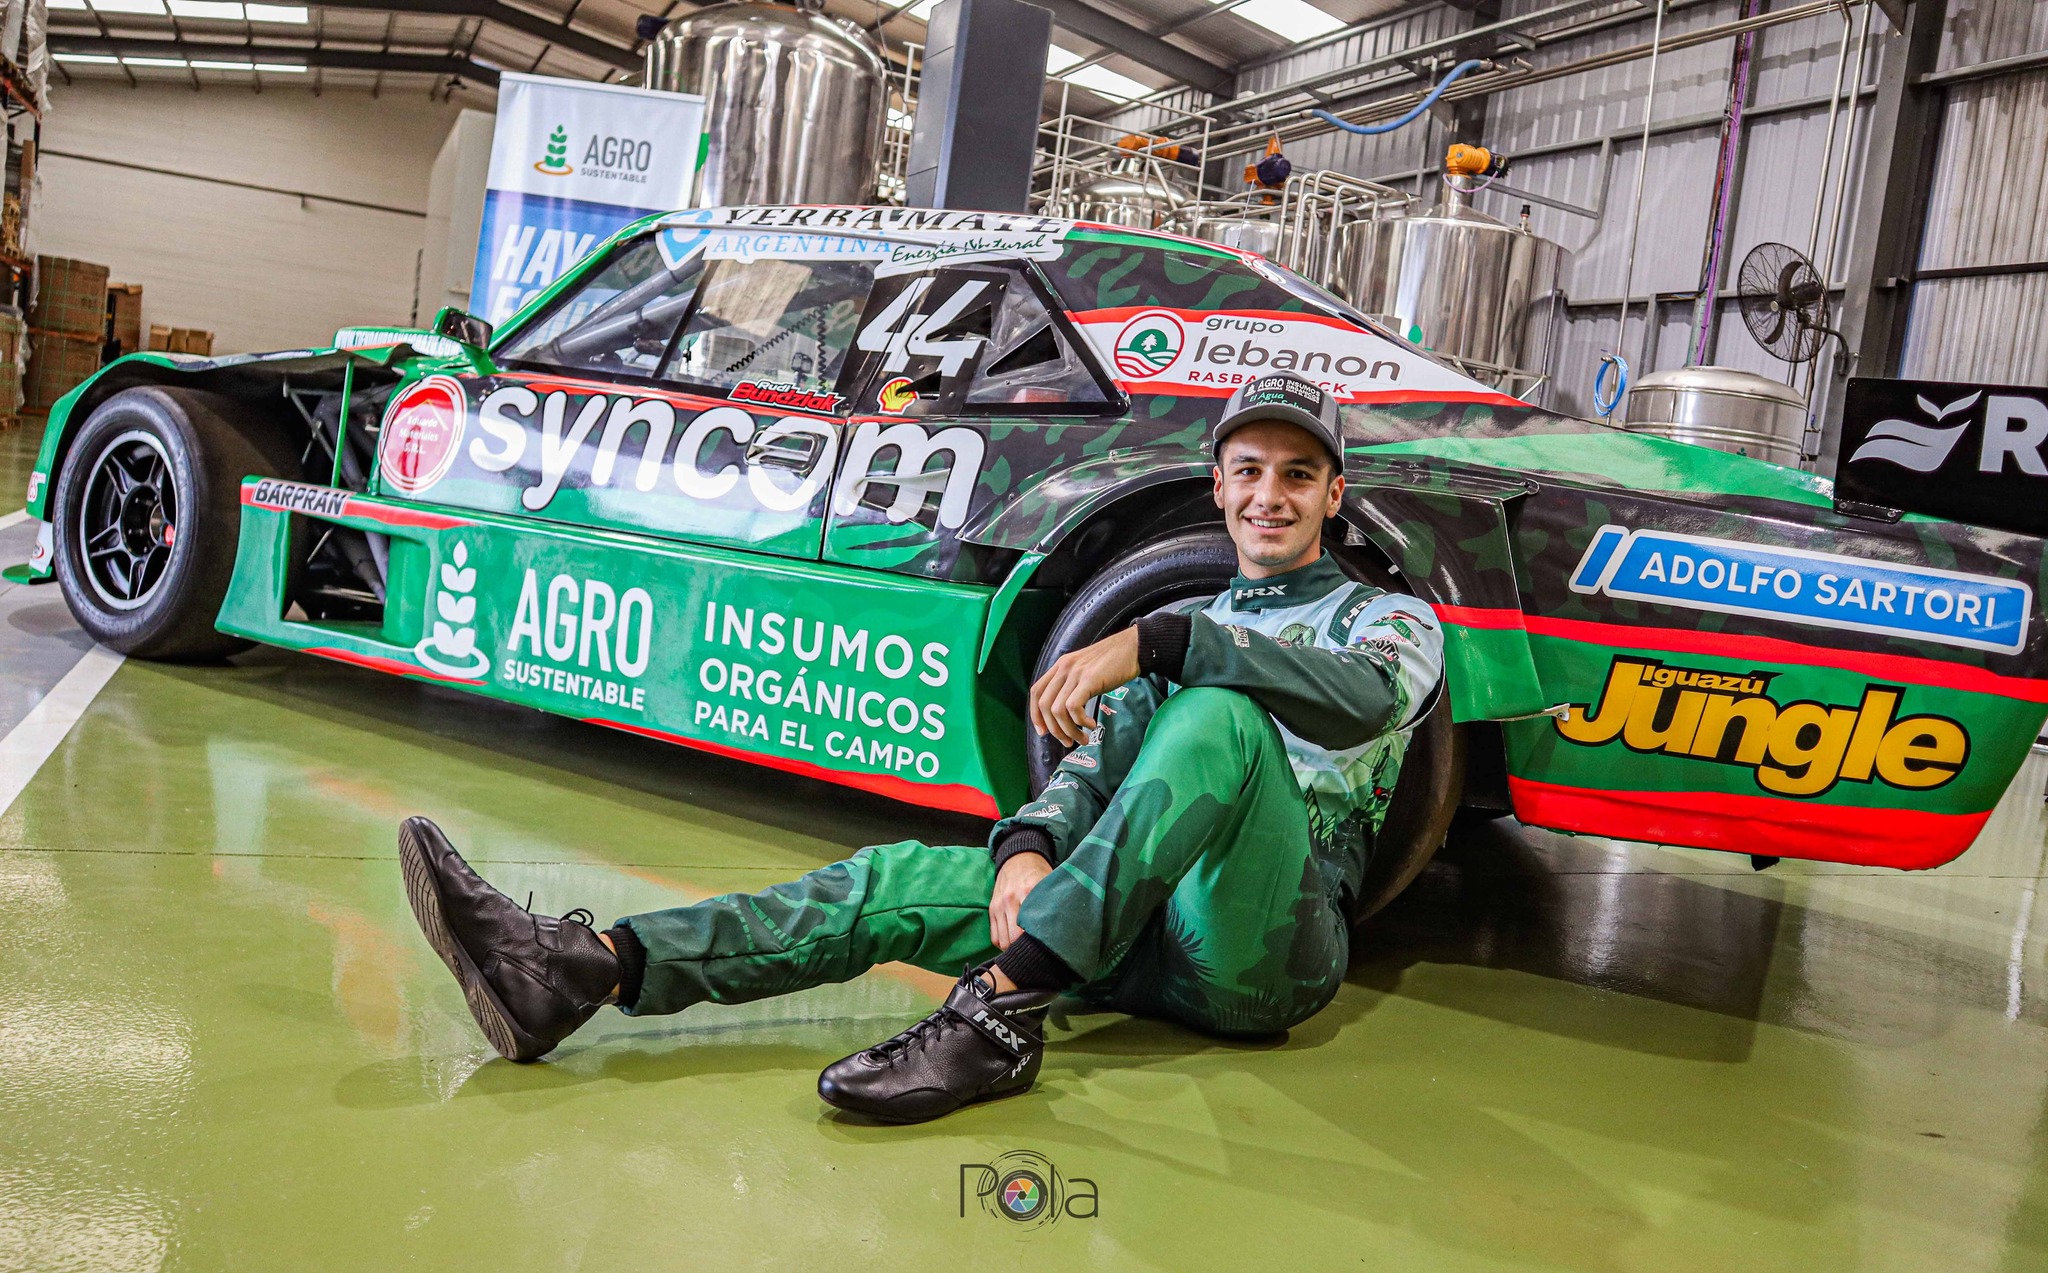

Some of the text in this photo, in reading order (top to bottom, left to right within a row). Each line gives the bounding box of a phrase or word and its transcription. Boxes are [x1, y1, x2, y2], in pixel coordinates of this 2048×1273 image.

[582, 134, 652, 172] AGRO
[580, 167, 648, 184] SUSTENTABLE
[897, 210, 1068, 234] MATE
[492, 224, 596, 285] HAY
[713, 232, 892, 257] ARGENTINA
[855, 276, 990, 377] 44
[1205, 316, 1285, 335] grupo
[1193, 336, 1401, 382] lebanon
[732, 382, 839, 411] Bundziak
[756, 381, 792, 392] Rudi
[1257, 392, 1285, 401] Agua
[1258, 378, 1284, 389] AGRO
[1286, 379, 1321, 397] INSUMOS
[398, 428, 438, 442] Materiales
[407, 416, 438, 428] Eduardo
[467, 384, 986, 531] syncom
[255, 482, 347, 515] BARPRAN
[1235, 584, 1288, 600] HRX
[1639, 551, 1997, 628] ADOLFO SARTORI
[506, 567, 654, 679] AGRO
[704, 601, 950, 688] INSUMOS
[503, 658, 646, 712] SUSTENTABLE
[1642, 664, 1765, 694] Iguazú
[699, 657, 947, 741] ORGÁNICOS
[694, 700, 941, 778] PARA EL CAMPO
[1556, 661, 1967, 795] Jungle
[972, 1009, 1028, 1052] HRX
